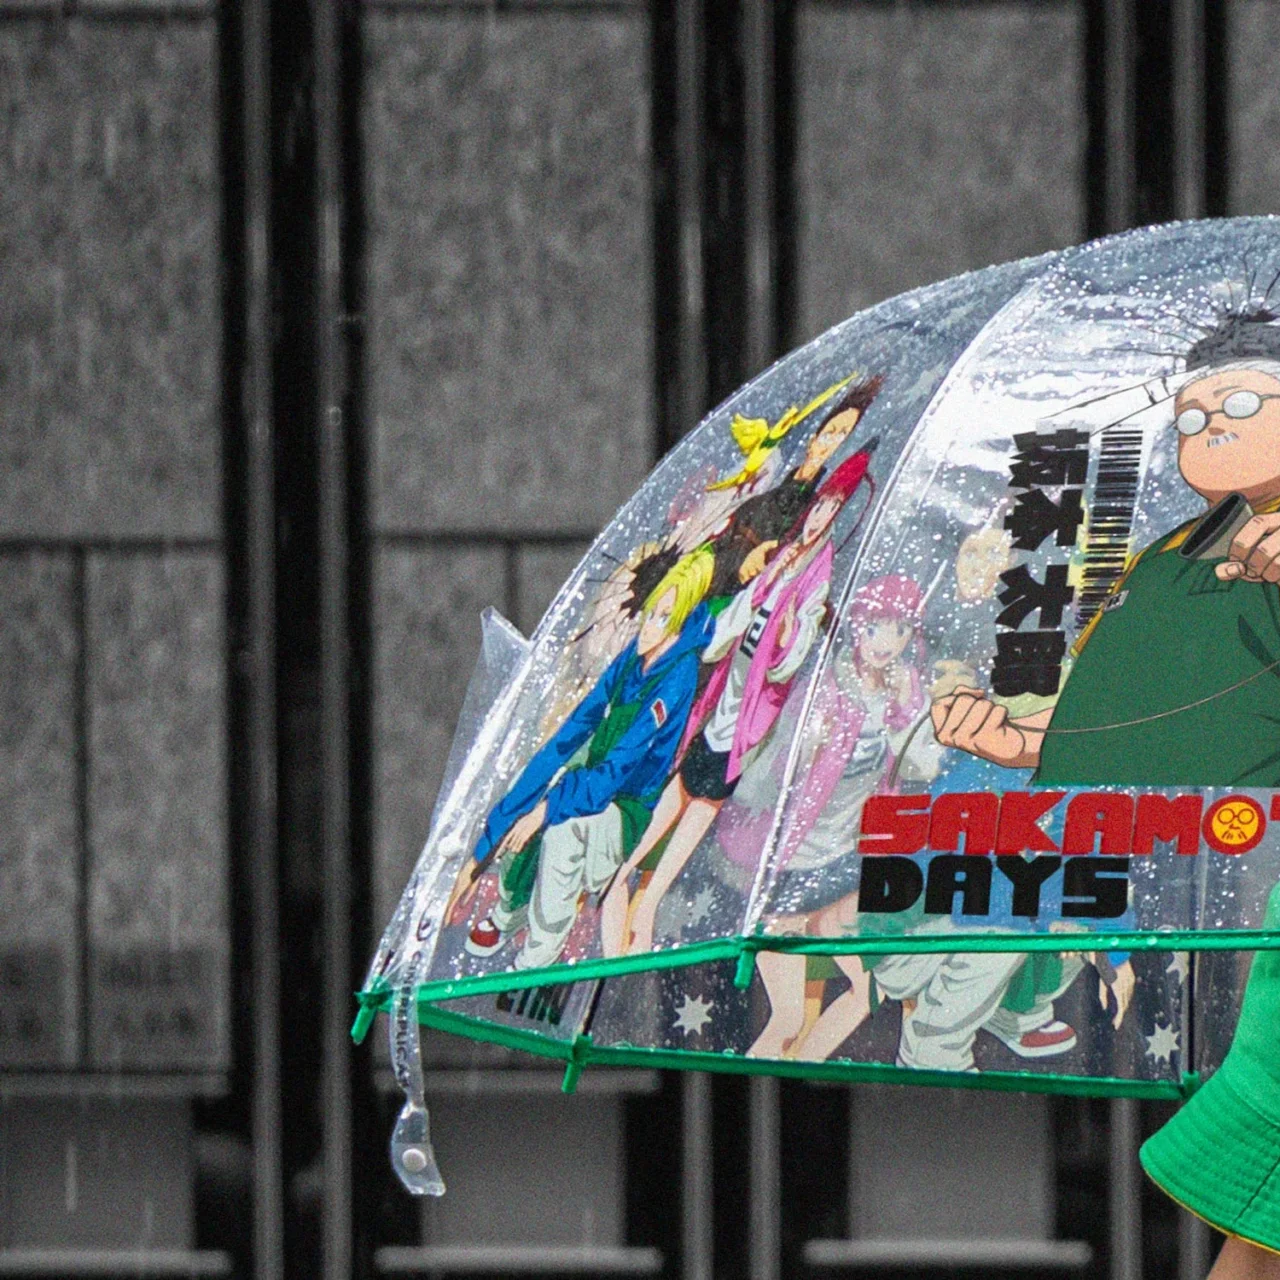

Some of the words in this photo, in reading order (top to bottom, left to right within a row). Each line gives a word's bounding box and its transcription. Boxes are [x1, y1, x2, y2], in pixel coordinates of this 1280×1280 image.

[990, 428, 1091, 697] 坂本太郎
[858, 855, 1129, 918] DAYS
